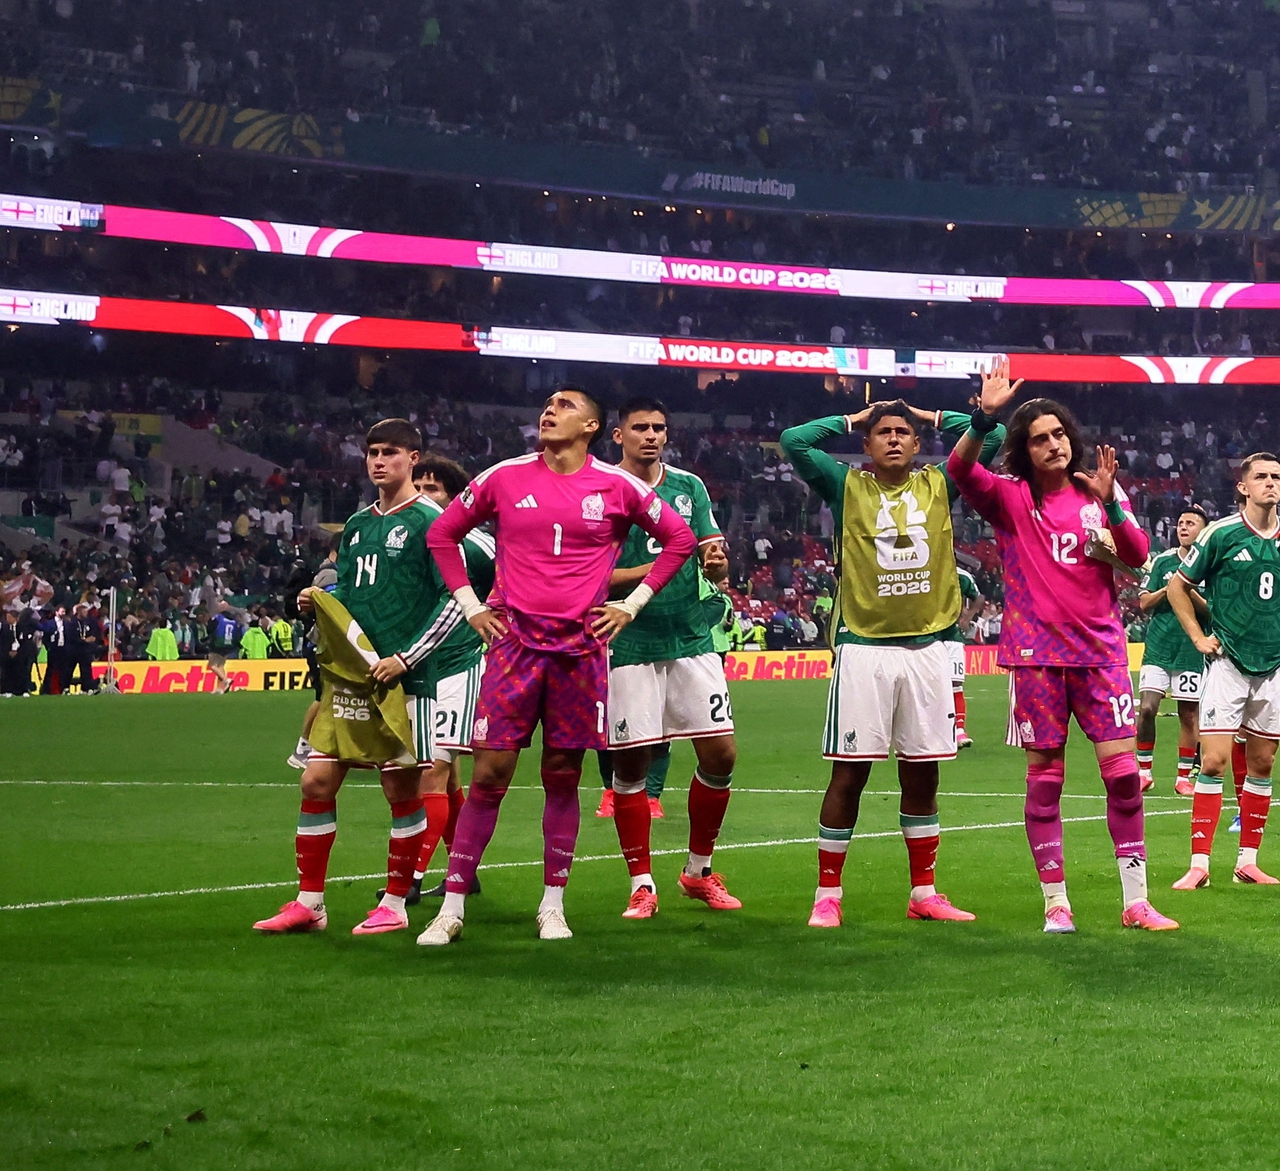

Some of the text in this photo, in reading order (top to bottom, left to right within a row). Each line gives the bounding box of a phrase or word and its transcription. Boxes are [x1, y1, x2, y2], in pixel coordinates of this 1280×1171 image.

[691, 171, 796, 200] #FIFAWorldCup
[505, 250, 559, 270] ENGLAND
[631, 259, 843, 291] FIFA WORLD CUP 2026
[946, 279, 1005, 298] ENGLAND
[32, 297, 97, 321] ENGLAND
[502, 333, 556, 353] ENGLAND
[628, 341, 667, 360] FIFA
[668, 344, 736, 364] WORLD
[736, 348, 774, 366] CUP
[552, 522, 563, 556] 1
[1050, 532, 1079, 565] 12
[893, 550, 919, 562] FIFA
[355, 553, 378, 587] 14
[877, 570, 931, 583] WORLD CUP
[877, 580, 931, 597] 2026
[1258, 571, 1274, 600] 8
[723, 652, 828, 681] Be Active
[953, 662, 964, 676] 16
[1179, 674, 1198, 693] 25
[333, 705, 371, 722] 026
[596, 701, 605, 733] 1
[1109, 693, 1136, 728] 12
[436, 710, 458, 738] 21
